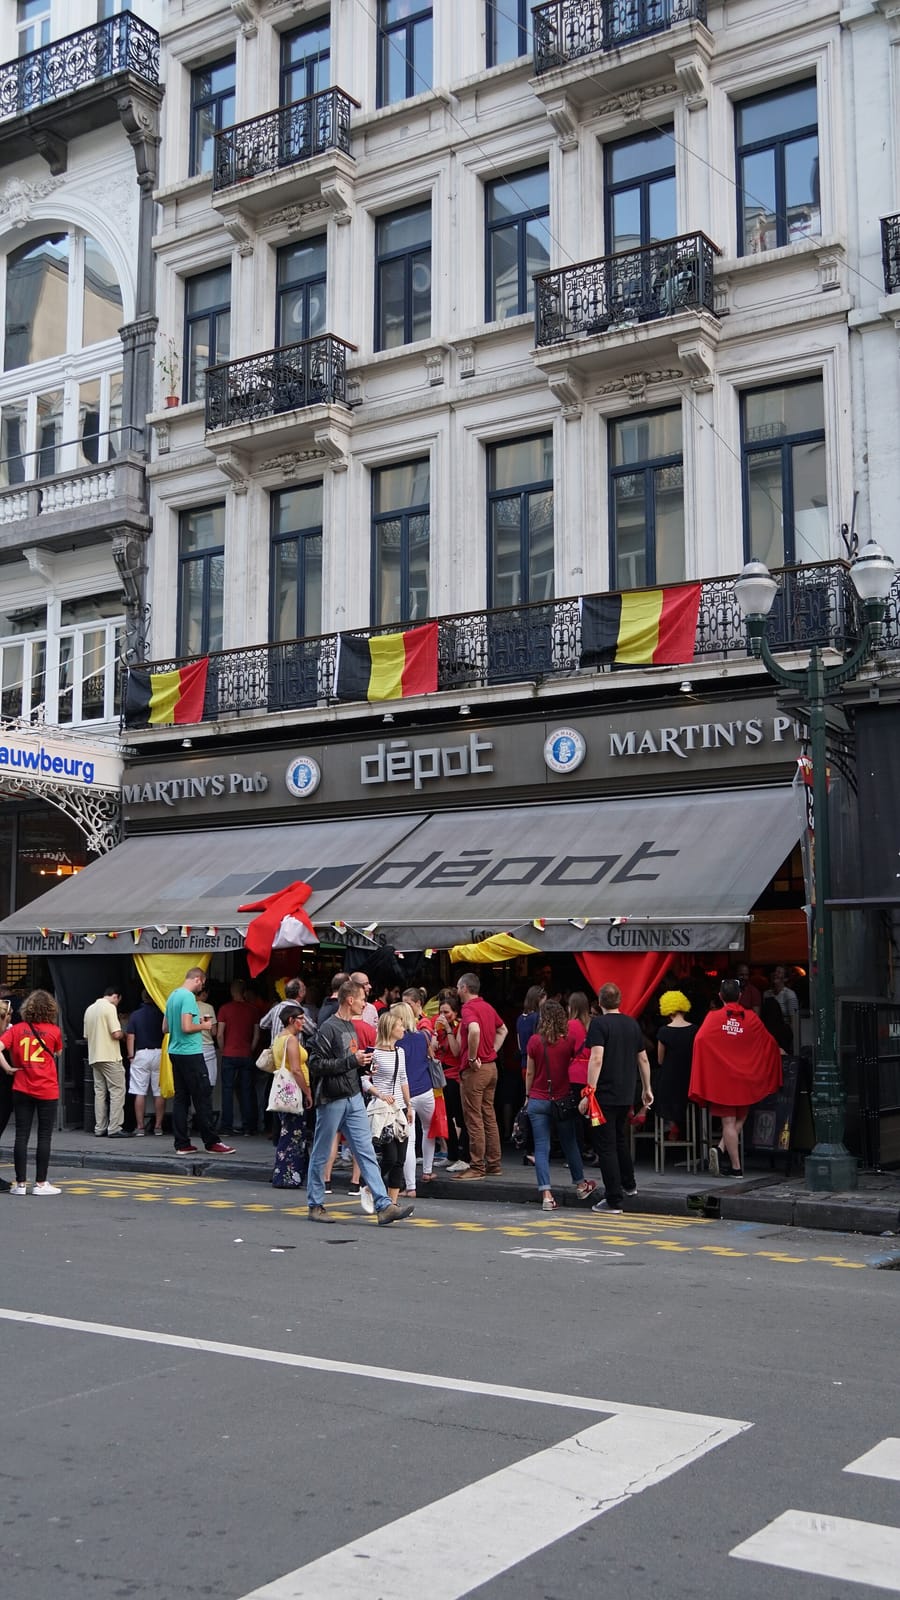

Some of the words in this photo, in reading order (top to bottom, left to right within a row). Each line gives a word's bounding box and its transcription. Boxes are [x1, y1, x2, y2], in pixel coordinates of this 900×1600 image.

[608, 718, 763, 758] MARTIN'S
[0, 746, 95, 784] auwbeurg
[122, 773, 225, 806] MARTIN'S
[229, 771, 268, 794] Pub
[151, 936, 185, 949] Gordon
[189, 935, 220, 949] Finest
[607, 926, 690, 947] GUINNESS
[20, 1036, 46, 1062] 12
